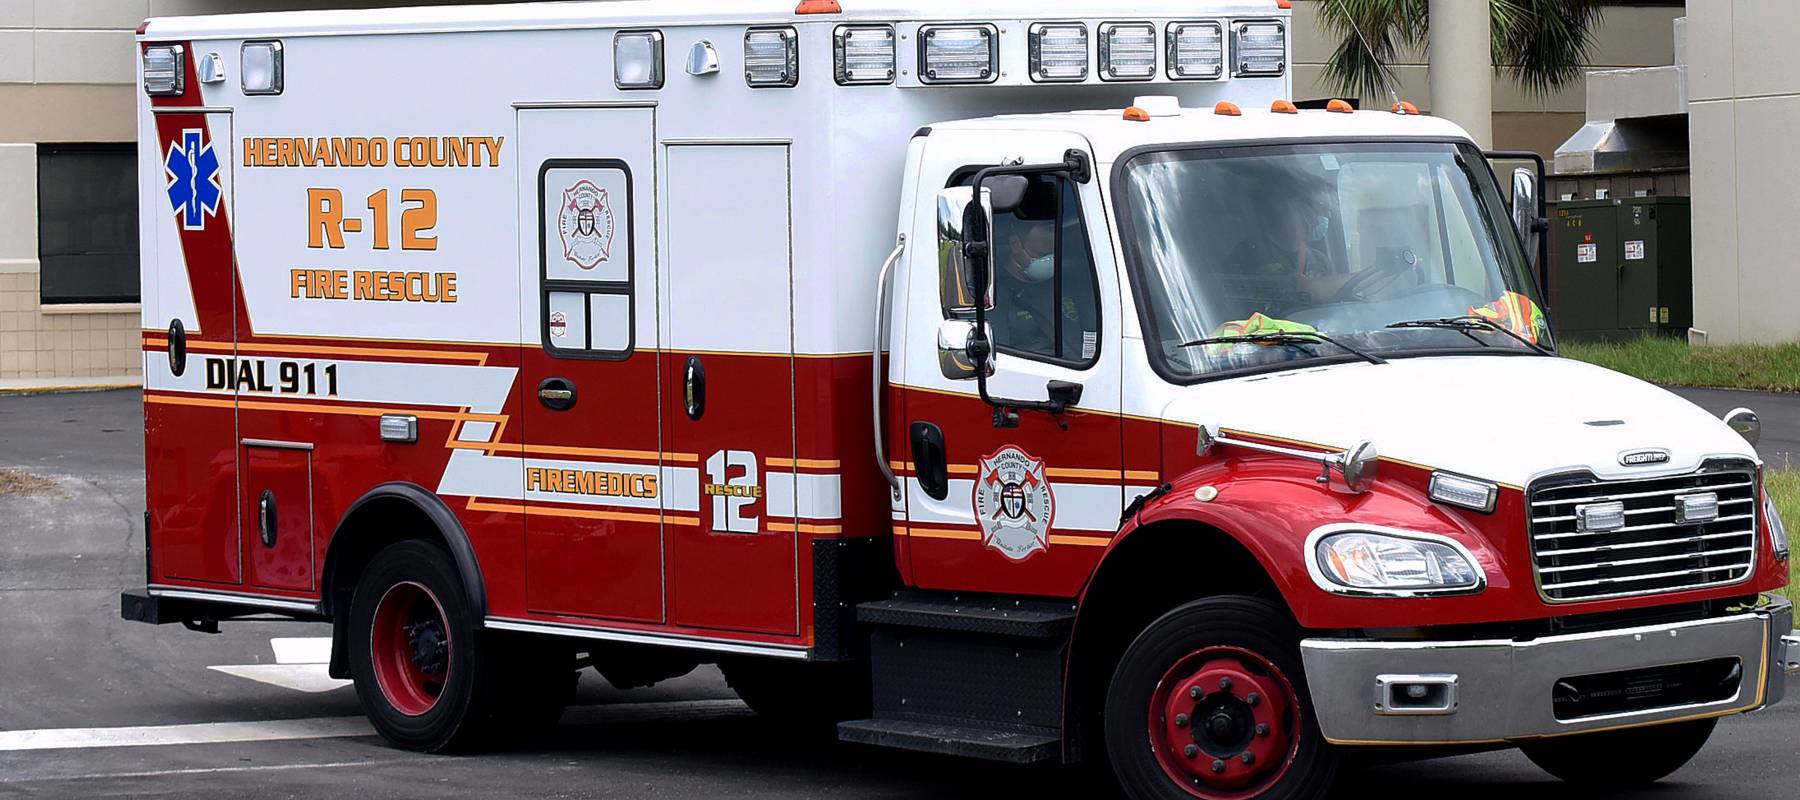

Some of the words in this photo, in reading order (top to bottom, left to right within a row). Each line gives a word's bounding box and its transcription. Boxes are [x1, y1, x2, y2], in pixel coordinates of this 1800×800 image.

[243, 137, 389, 167] HERNANDO
[393, 136, 504, 167] COUNTY
[573, 186, 599, 198] HERNANDO
[306, 187, 439, 251] R-12
[290, 269, 349, 300] FIRE
[353, 270, 458, 303] RESCUE
[205, 357, 274, 393] DIAL
[279, 361, 338, 397] 911
[993, 452, 1031, 468] HERNANDO
[1001, 461, 1023, 471] COUNTY
[526, 467, 658, 499] FIREMEDICS
[704, 482, 763, 499] RESCUE
[706, 449, 760, 534] 12
[1040, 485, 1050, 526] RESCUE
